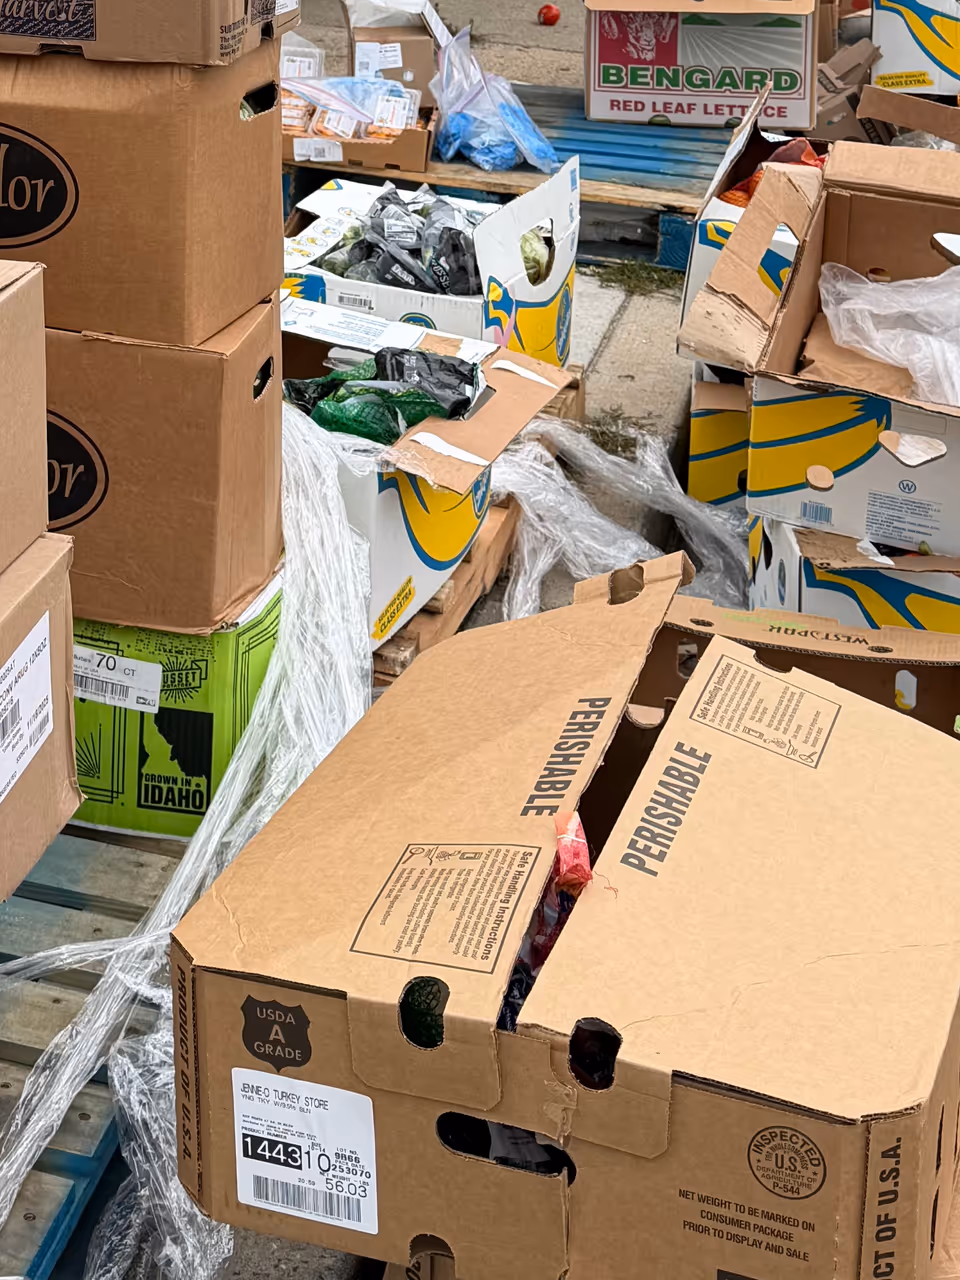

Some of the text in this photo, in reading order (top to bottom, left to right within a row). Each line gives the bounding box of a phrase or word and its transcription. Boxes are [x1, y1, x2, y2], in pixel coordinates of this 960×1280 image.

[601, 64, 801, 93] BENGARD
[610, 99, 788, 119] RED LEAF LETTCE
[96, 652, 136, 677] 70 CT
[163, 671, 197, 684] USSET
[520, 697, 612, 817] PERISHABLE
[144, 773, 191, 786] GROWN IN
[144, 782, 204, 810] IDAHO
[619, 741, 712, 877] PERISHABLE
[481, 851, 533, 961] Safe Handling Instructions
[256, 1006, 296, 1025] USDA
[268, 1024, 286, 1044] A
[254, 1041, 302, 1061] GRADE
[176, 964, 194, 1161] PRODUCT OF U.S.A.
[241, 1094, 270, 1105] YNG TKY
[273, 1089, 329, 1111] TURKEY STORE
[752, 1130, 821, 1167] INSPECTED
[331, 1163, 372, 1179] 253070
[756, 1165, 805, 1180] DEPARTMENT
[775, 1153, 801, 1174] U.S.
[879, 1136, 902, 1204] U.S.A.
[326, 1178, 368, 1198] 56.03
[761, 1173, 813, 1190] AGRICULTURE
[773, 1181, 800, 1195] P-544
[679, 1188, 816, 1233] NET WEIGHT TO BE MARKED ON
[700, 1209, 794, 1243] CONSUMER PACKAGE
[875, 1211, 898, 1243] OF
[683, 1220, 810, 1262] PRIOR TO DISPLAY AND SALE
